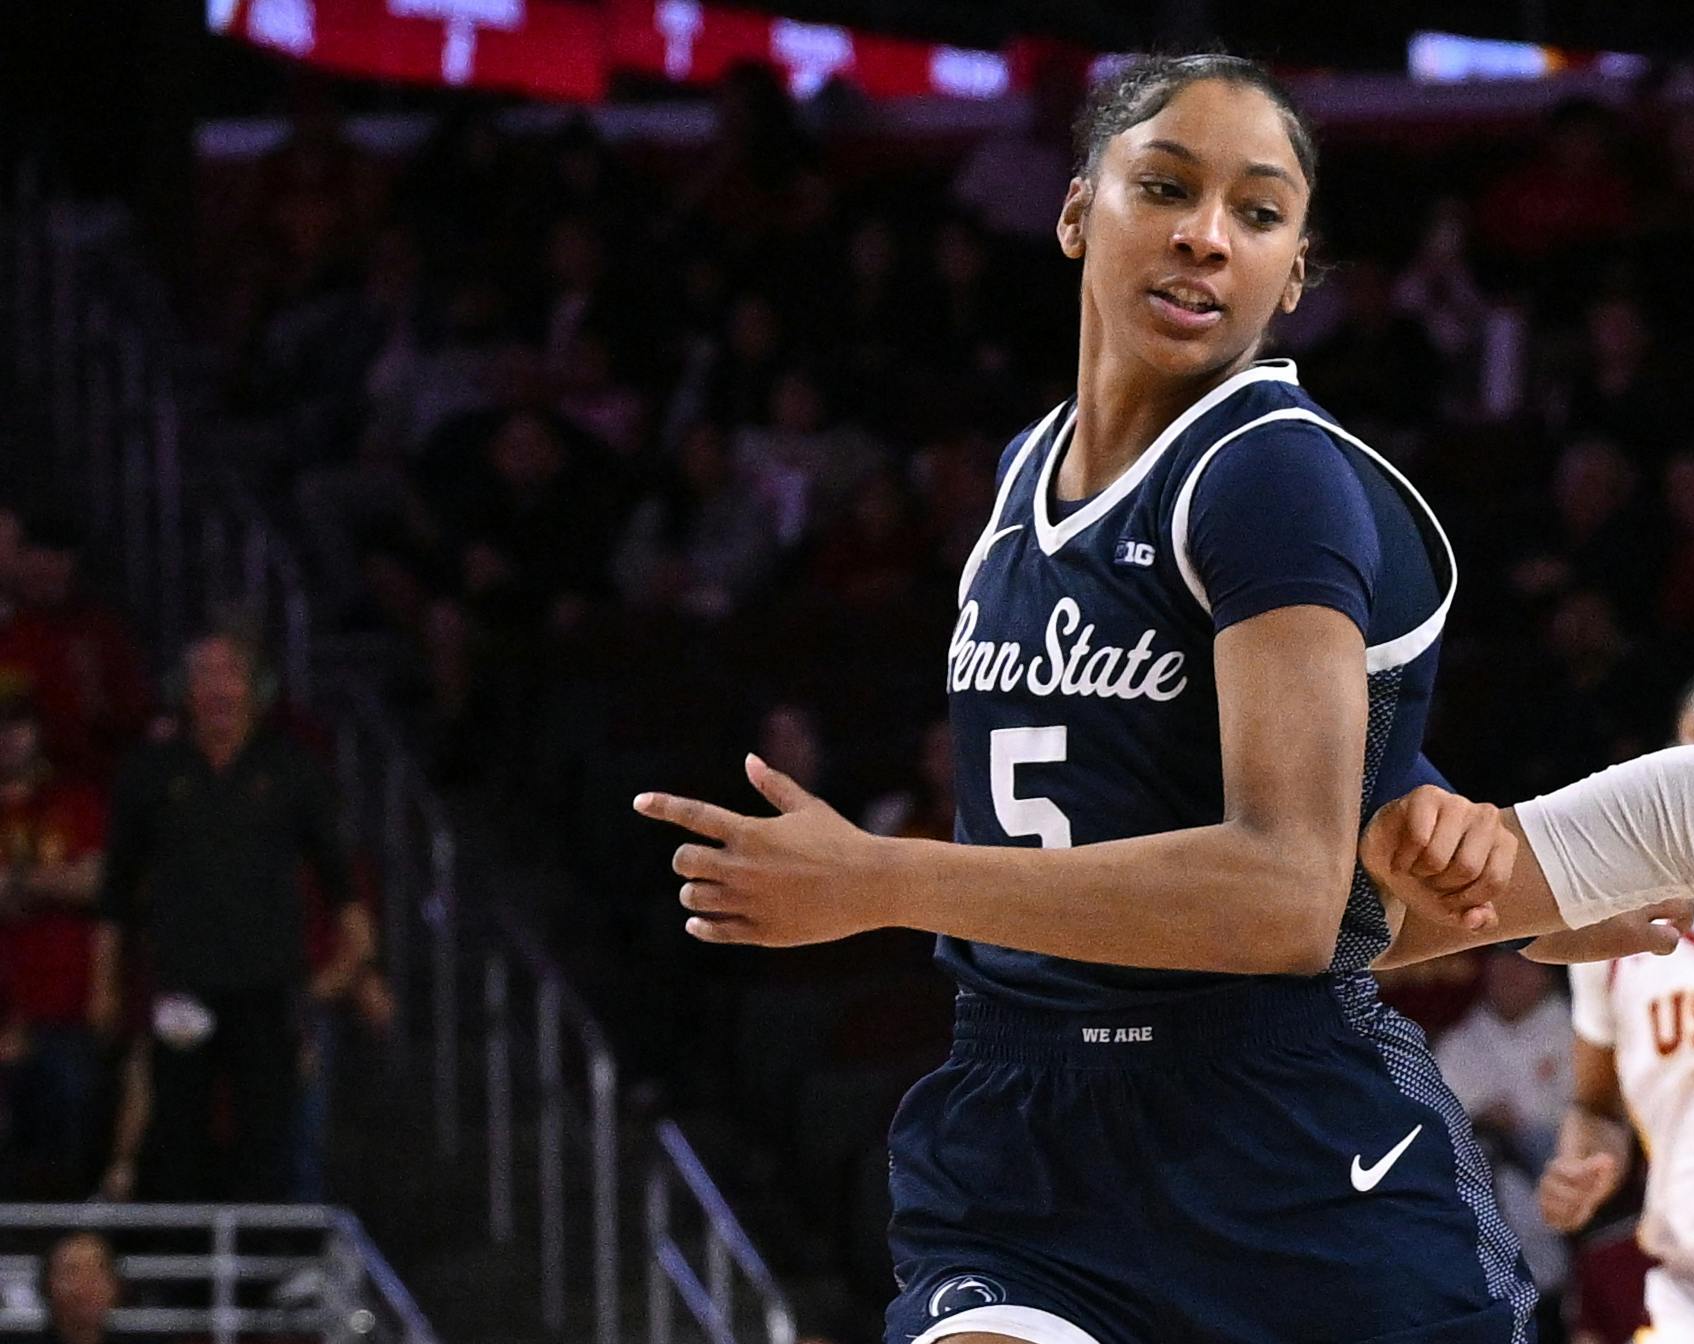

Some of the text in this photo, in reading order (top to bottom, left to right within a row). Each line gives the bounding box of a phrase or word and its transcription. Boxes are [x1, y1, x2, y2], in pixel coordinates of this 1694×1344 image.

[1027, 597, 1188, 701] State
[990, 725, 1071, 849] 5
[1082, 1026, 1153, 1042] WE ARE
